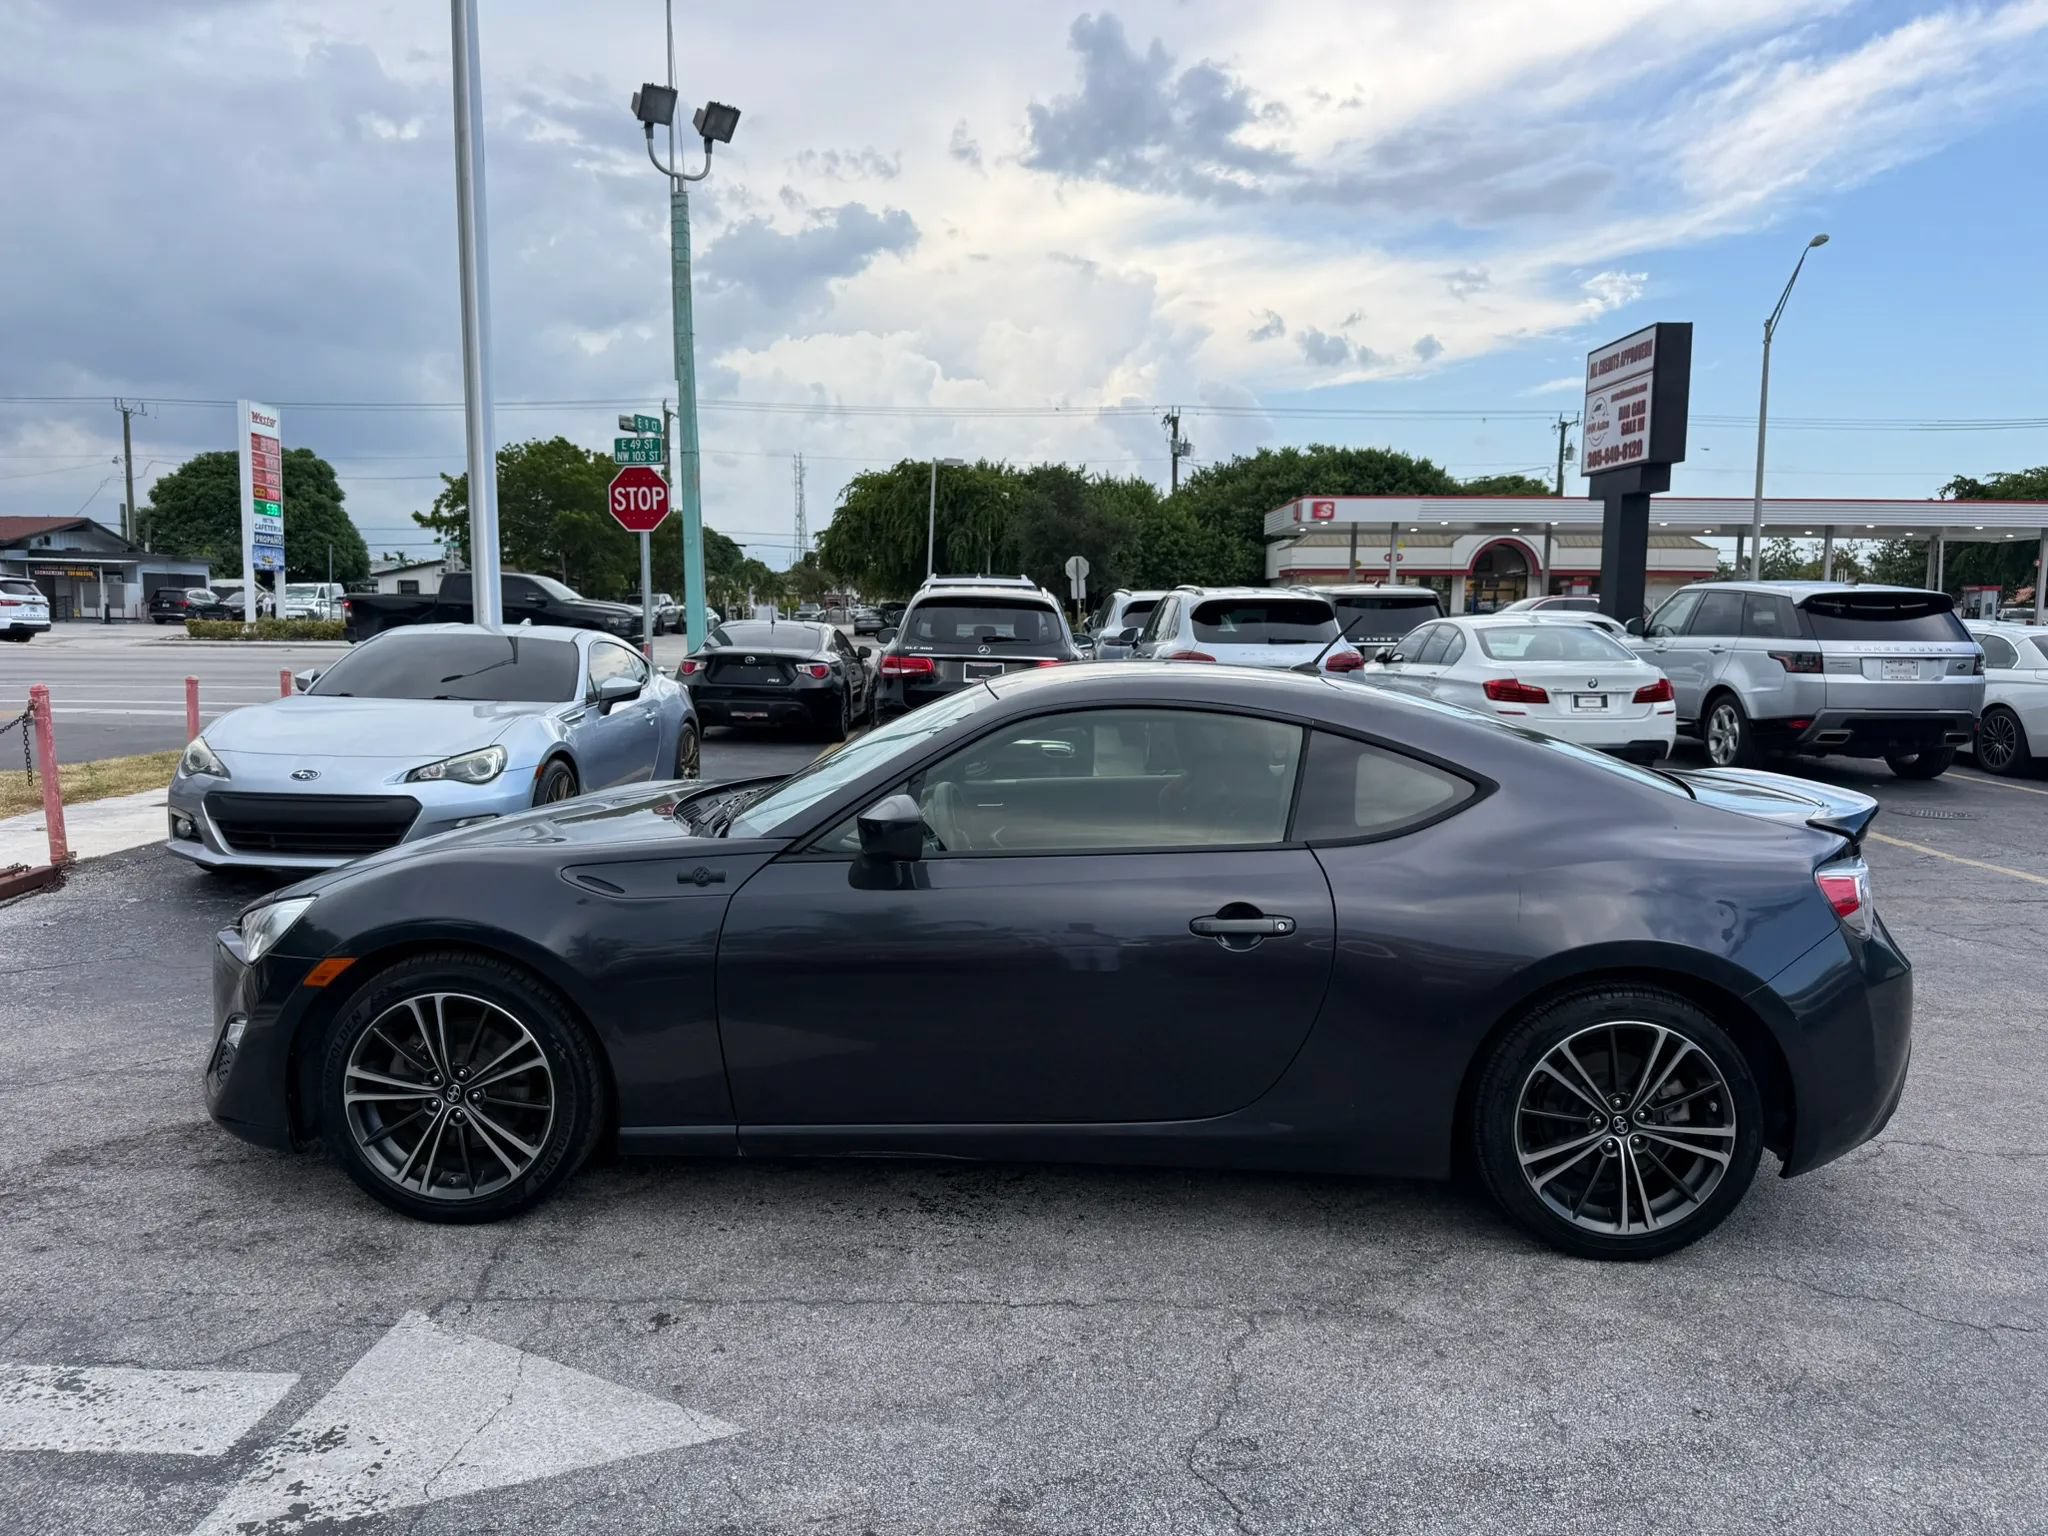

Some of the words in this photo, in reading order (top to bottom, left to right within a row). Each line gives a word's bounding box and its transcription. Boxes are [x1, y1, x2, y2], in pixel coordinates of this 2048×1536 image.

[637, 418, 642, 428] E
[645, 419, 649, 429] 9
[651, 421, 658, 432] CT
[621, 440, 627, 449] E
[630, 439, 641, 450] 49
[644, 440, 654, 449] ST
[617, 452, 629, 461] NW
[632, 451, 646, 462] 103
[649, 451, 659, 461] ST
[614, 486, 665, 511] STOP
